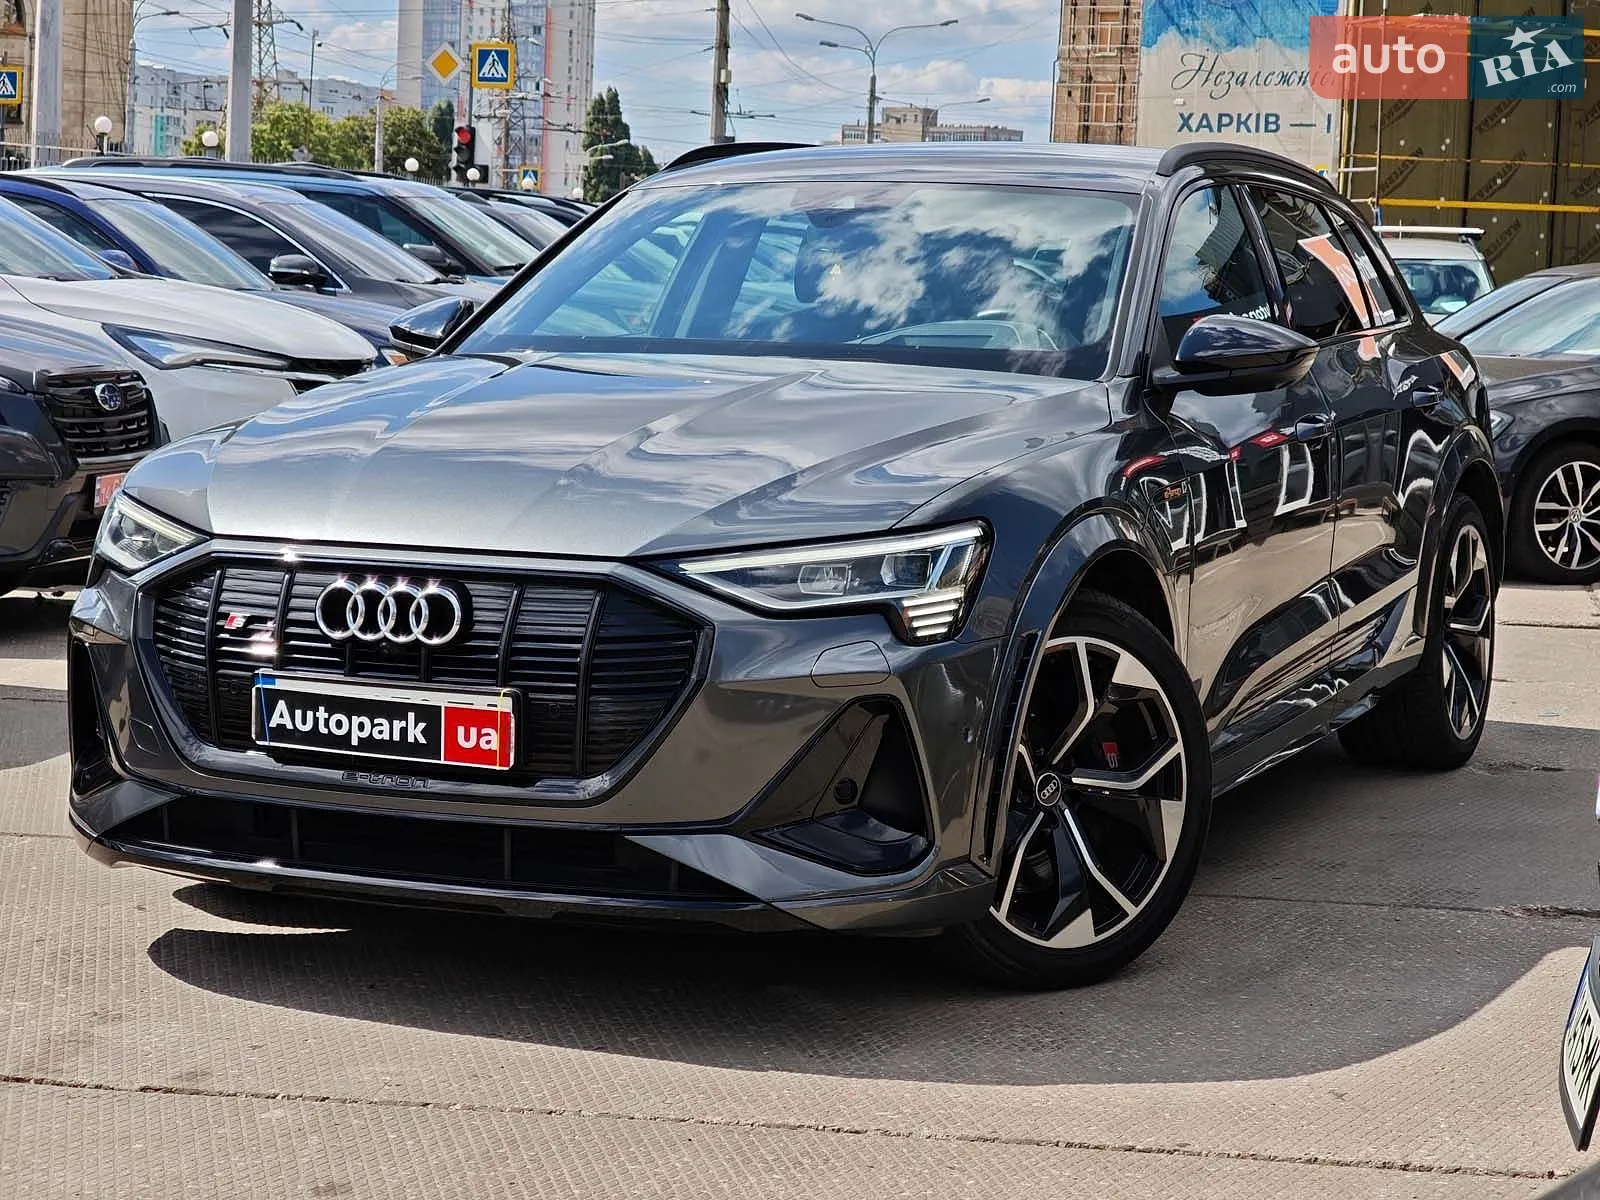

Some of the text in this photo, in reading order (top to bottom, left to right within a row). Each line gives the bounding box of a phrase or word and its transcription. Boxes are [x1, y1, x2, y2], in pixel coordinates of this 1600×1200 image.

[1177, 112, 1281, 134] ХАРКІВ
[269, 699, 499, 751] Autopark ua
